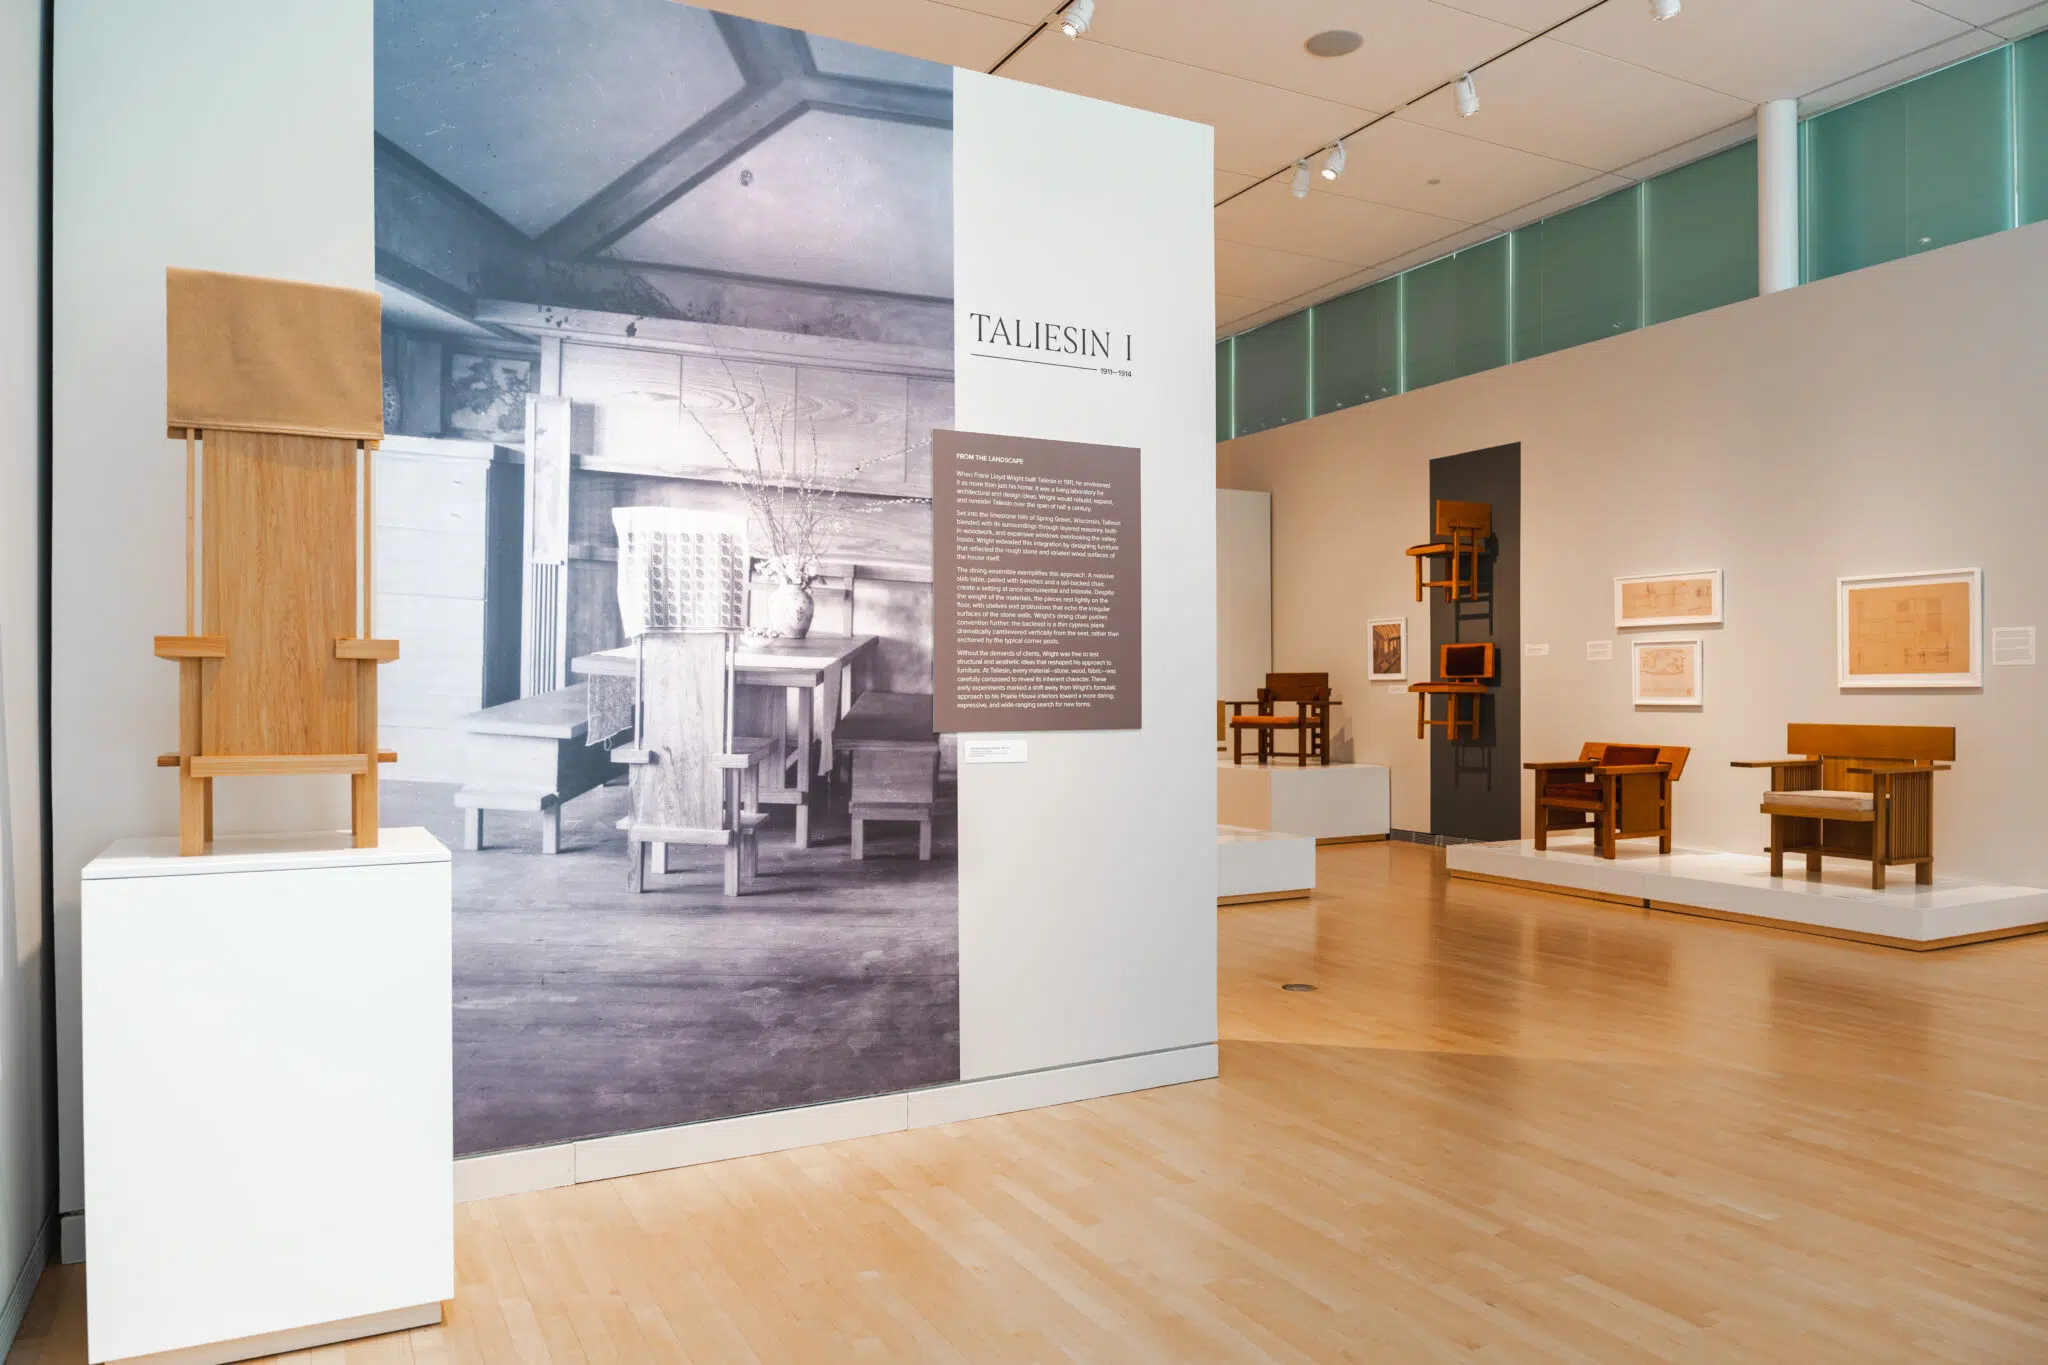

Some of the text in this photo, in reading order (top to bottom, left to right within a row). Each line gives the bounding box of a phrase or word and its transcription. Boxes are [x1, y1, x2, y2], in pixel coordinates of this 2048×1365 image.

[970, 312, 1132, 361] TALIESIN I
[989, 456, 1023, 464] LANDSCAPE
